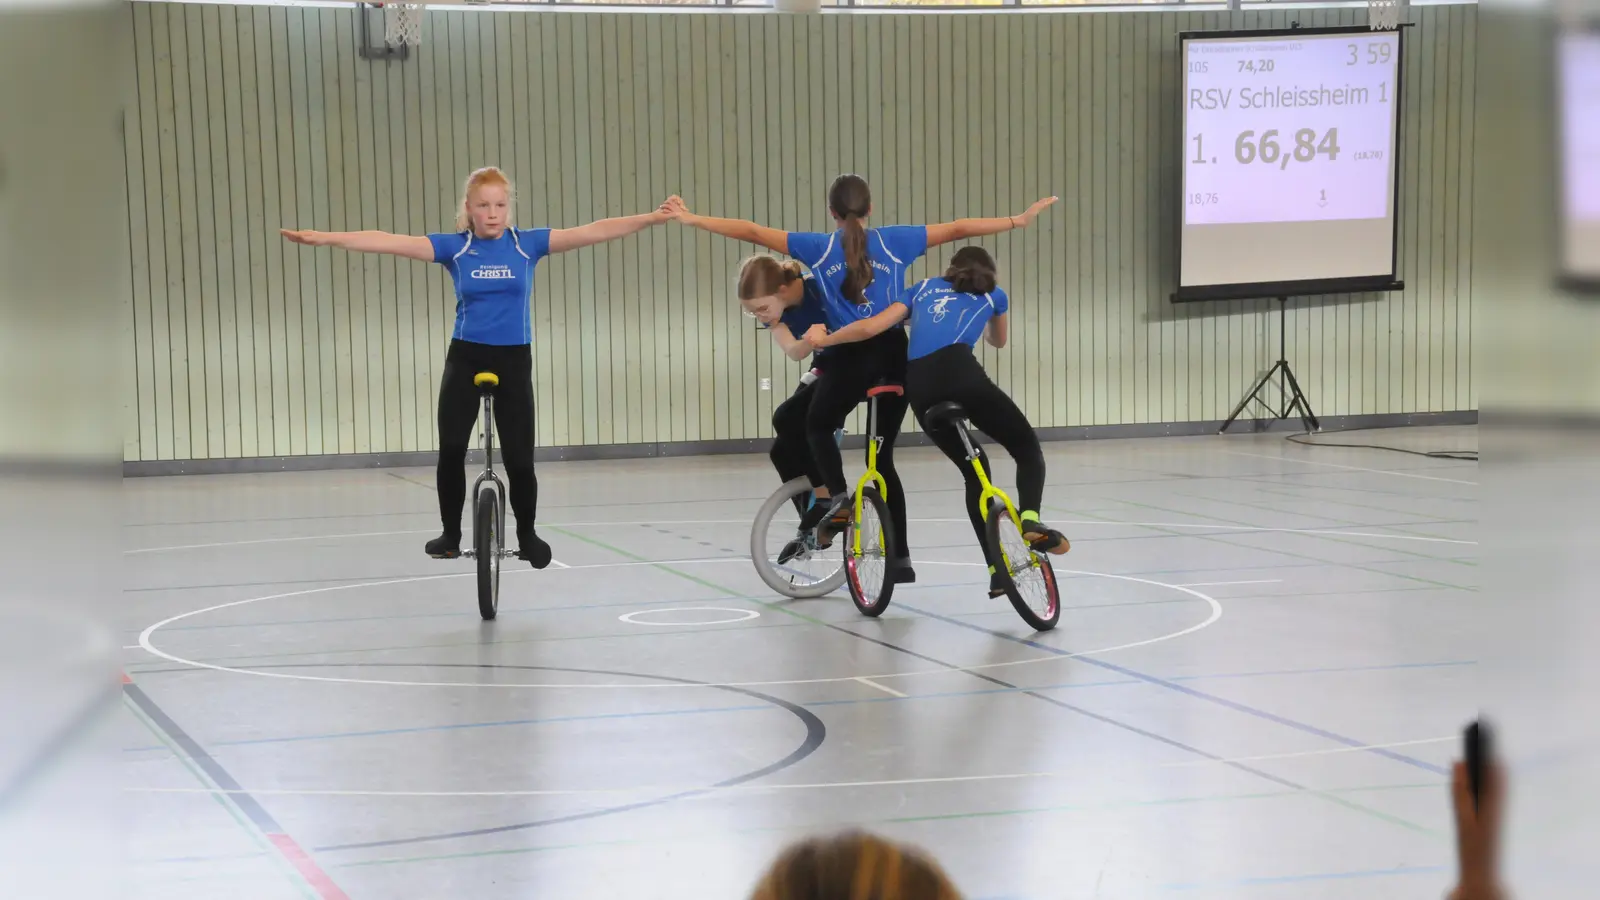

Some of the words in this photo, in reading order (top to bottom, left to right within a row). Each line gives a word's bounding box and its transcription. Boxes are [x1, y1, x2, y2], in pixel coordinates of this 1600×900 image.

[1346, 44, 1358, 66] 3
[1367, 42, 1392, 65] 59
[1188, 61, 1208, 73] 105
[1237, 59, 1275, 75] 74,20
[1190, 88, 1232, 110] RSV
[1239, 83, 1369, 109] Schleissheim
[1379, 82, 1388, 103] 1
[1192, 133, 1217, 164] 1.
[1234, 127, 1341, 171] 66,84
[1188, 192, 1219, 205] 18,76
[1319, 189, 1326, 201] 1
[470, 269, 516, 279] CHRISTL
[825, 262, 842, 277] RSV
